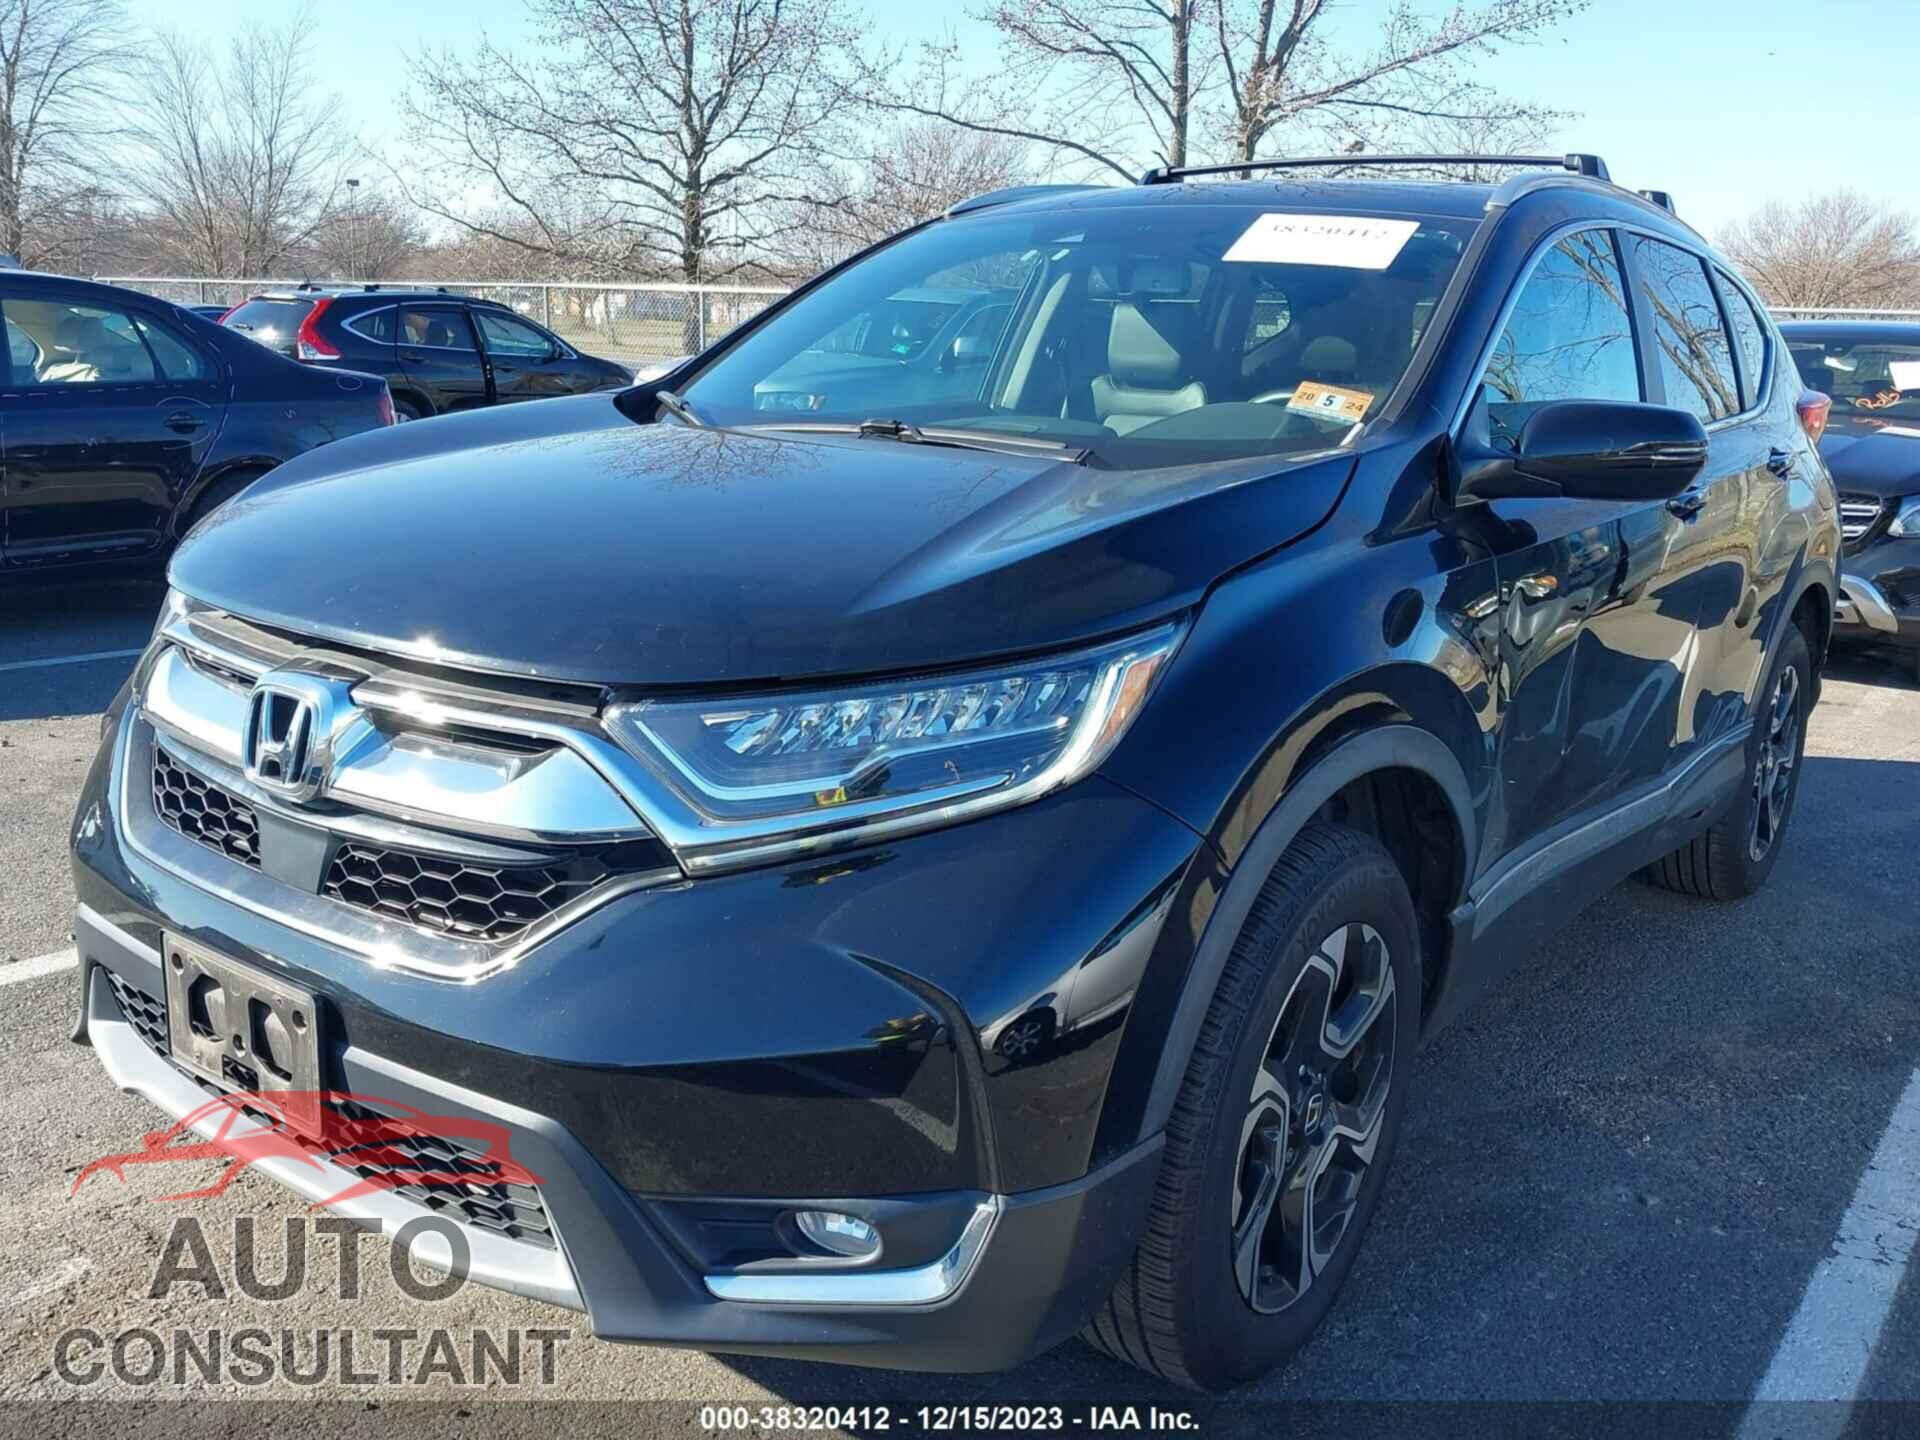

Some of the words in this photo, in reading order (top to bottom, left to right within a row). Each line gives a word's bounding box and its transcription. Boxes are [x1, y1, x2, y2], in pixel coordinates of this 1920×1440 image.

[1296, 391, 1314, 401] 20
[1322, 394, 1337, 407] 5
[1345, 402, 1364, 412] 24
